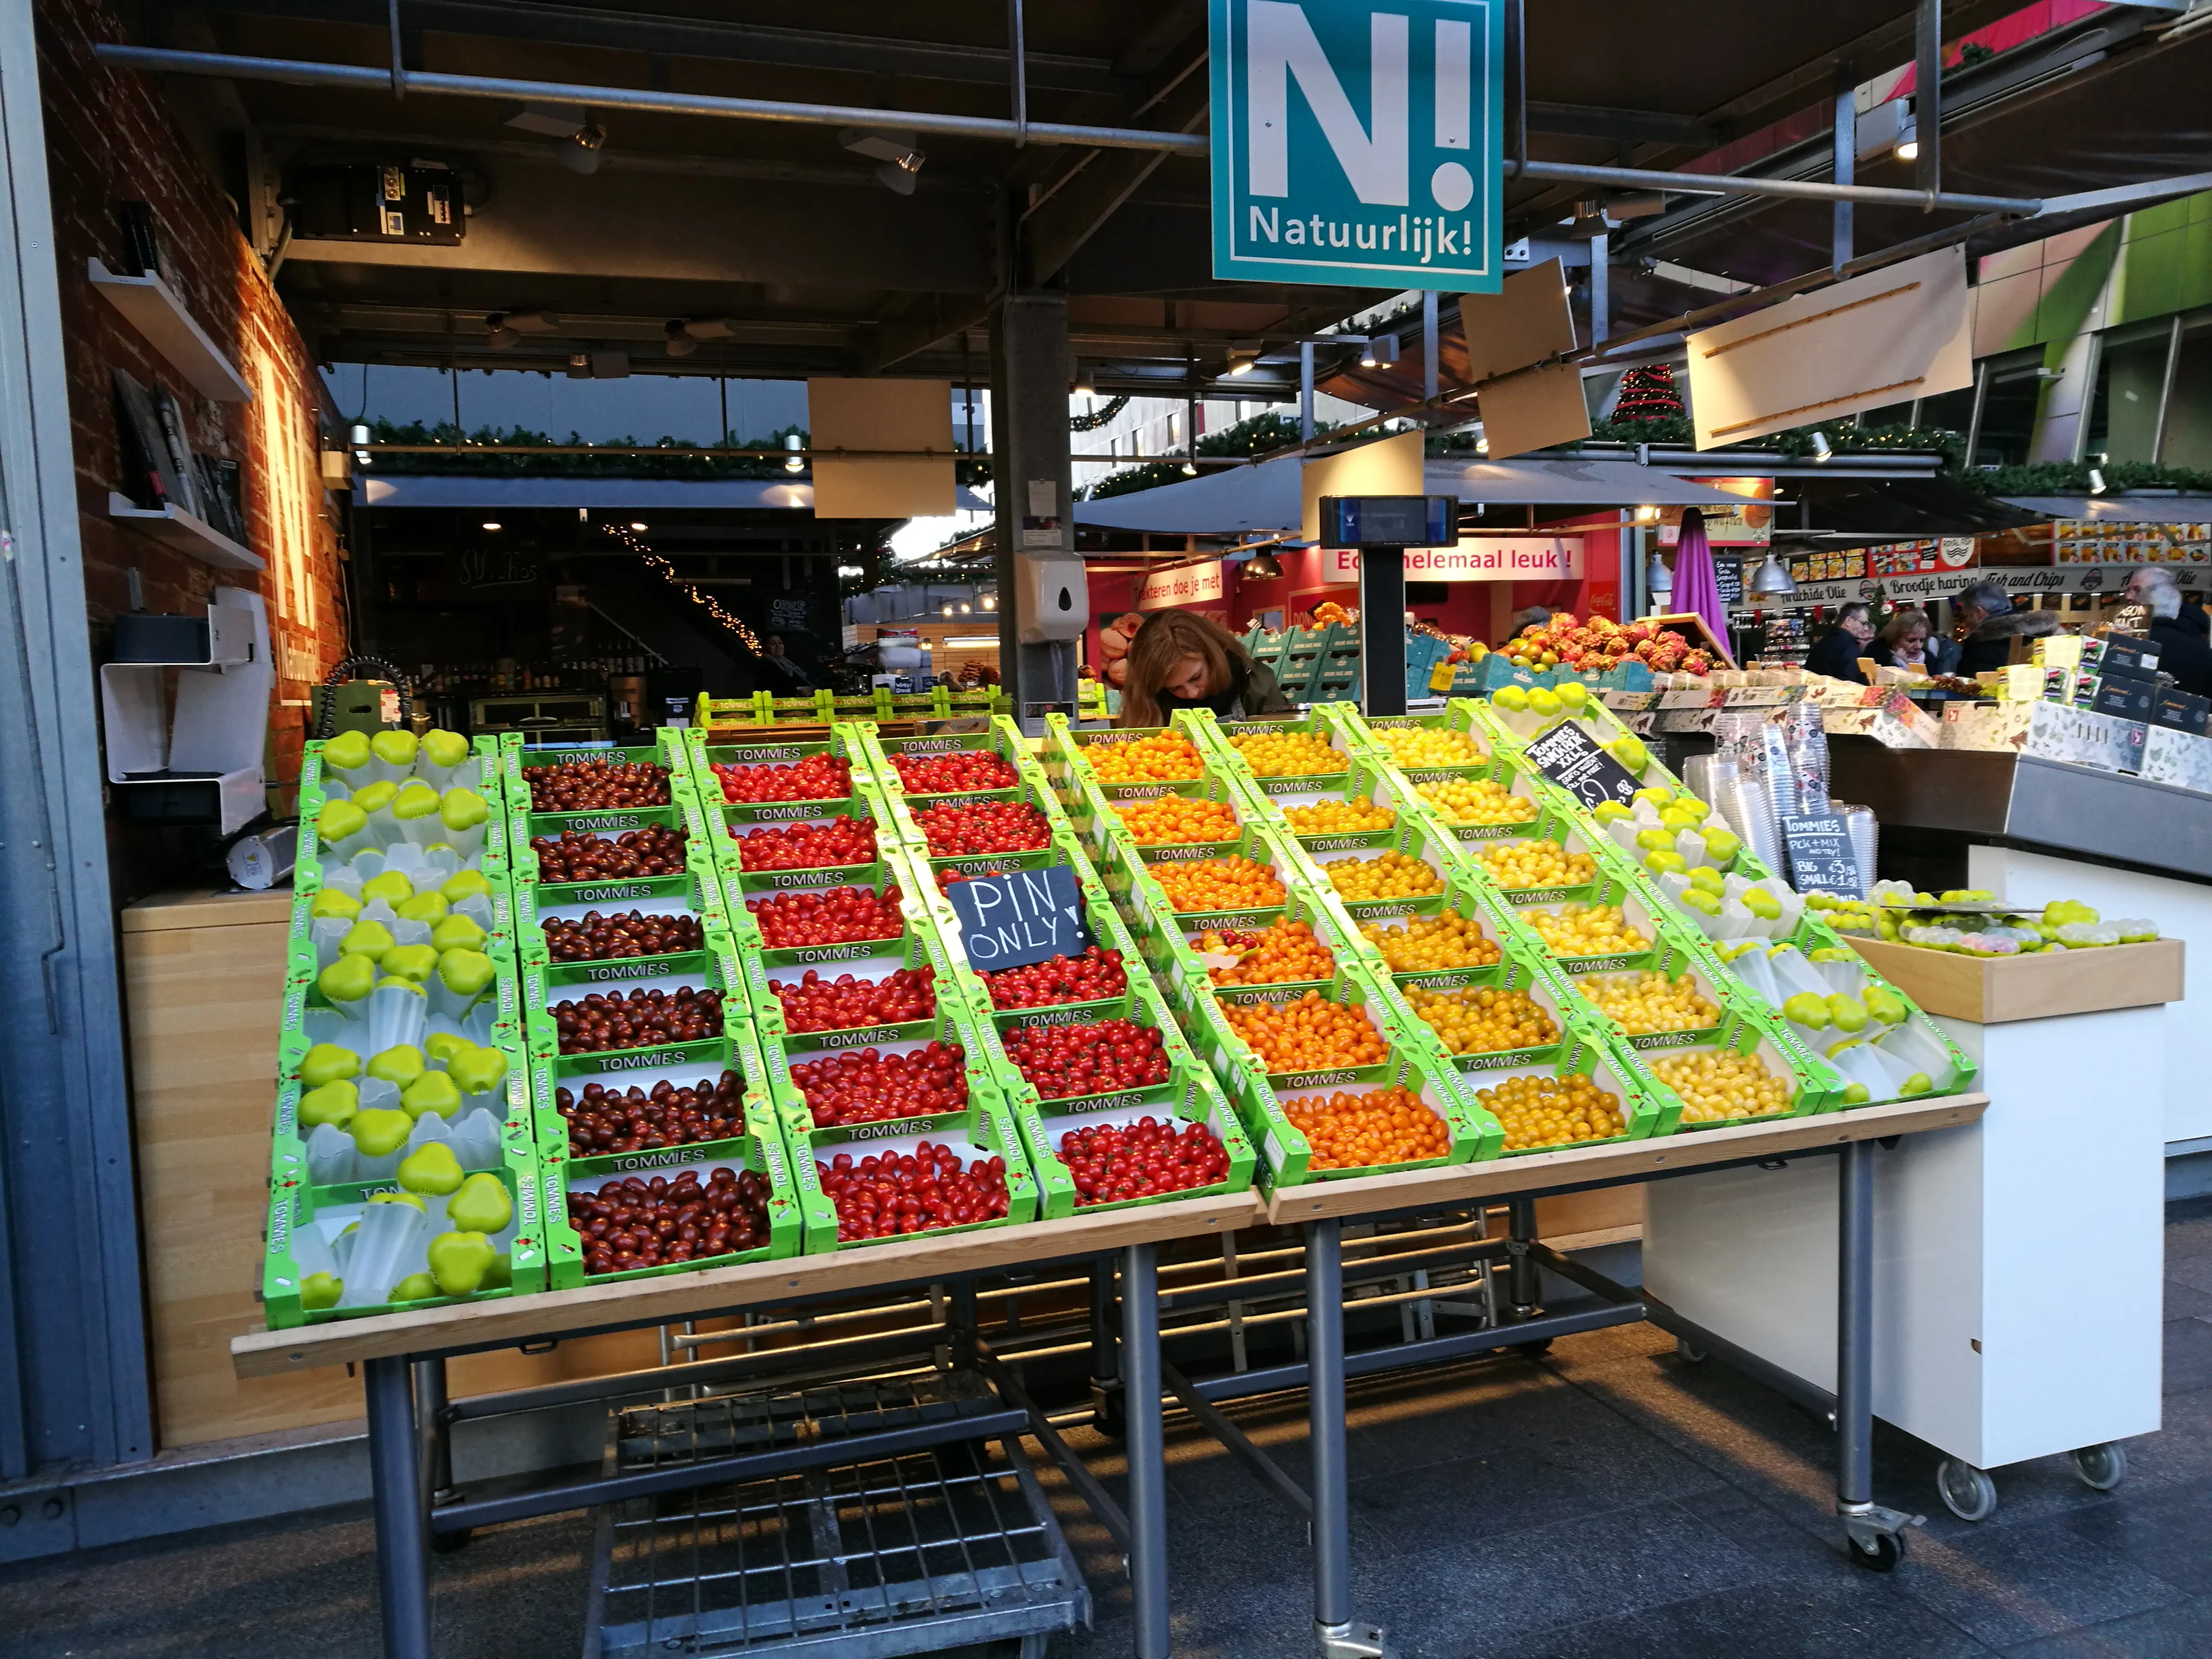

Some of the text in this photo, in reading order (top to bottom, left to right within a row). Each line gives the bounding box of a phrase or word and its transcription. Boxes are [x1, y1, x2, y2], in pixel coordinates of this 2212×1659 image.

[1247, 0, 1473, 211] N!
[1249, 206, 1472, 263] Natuurlijk!
[1511, 550, 1558, 568] leuk
[1566, 551, 1571, 567] !
[1173, 579, 1189, 594] doe
[1191, 576, 1199, 596] je
[1202, 573, 1219, 590] met
[1890, 577, 1936, 595] Broodje
[2009, 573, 2034, 586] and
[2035, 571, 2065, 590] Chips
[1826, 585, 1847, 599] Olie
[902, 739, 962, 753] TOMMIES
[556, 751, 627, 765] TOMMIES
[735, 748, 801, 760] TOMMIES
[1118, 786, 1176, 798] TOMMIES
[1267, 782, 1323, 793] TOMMIES
[754, 807, 822, 819] TOMMIES
[565, 816, 639, 830] TOMMIES
[1458, 827, 1514, 839] TOMMIES
[1311, 838, 1368, 850] TOMMIES
[1154, 847, 1215, 861] TOMMIES
[772, 872, 845, 887] TOMMIES
[1798, 874, 1830, 885] SMALL
[574, 885, 652, 901] TOMMIES
[1510, 891, 1566, 904] TOMMIES
[1355, 905, 1417, 917] TOMMIES
[1192, 917, 1258, 930] TOMMIES
[969, 905, 1085, 959] ONLY!
[795, 946, 872, 963] TOMMIES
[588, 963, 670, 980] TOMMIES
[1567, 959, 1627, 972] TOMMIES
[1235, 990, 1303, 1005] TOMMIES
[1021, 1010, 1093, 1029] TOMMIES
[819, 1030, 900, 1049] TOMMIES
[1634, 1034, 1696, 1047] TOMMIES
[599, 1051, 686, 1070] TOMMIES
[1466, 1054, 1532, 1070] TOMMIES
[1284, 1072, 1357, 1088] TOMMIES
[1066, 1094, 1143, 1113] TOMMIES
[849, 1120, 934, 1140] TOMMIES
[614, 1149, 706, 1171] TOMMIES
